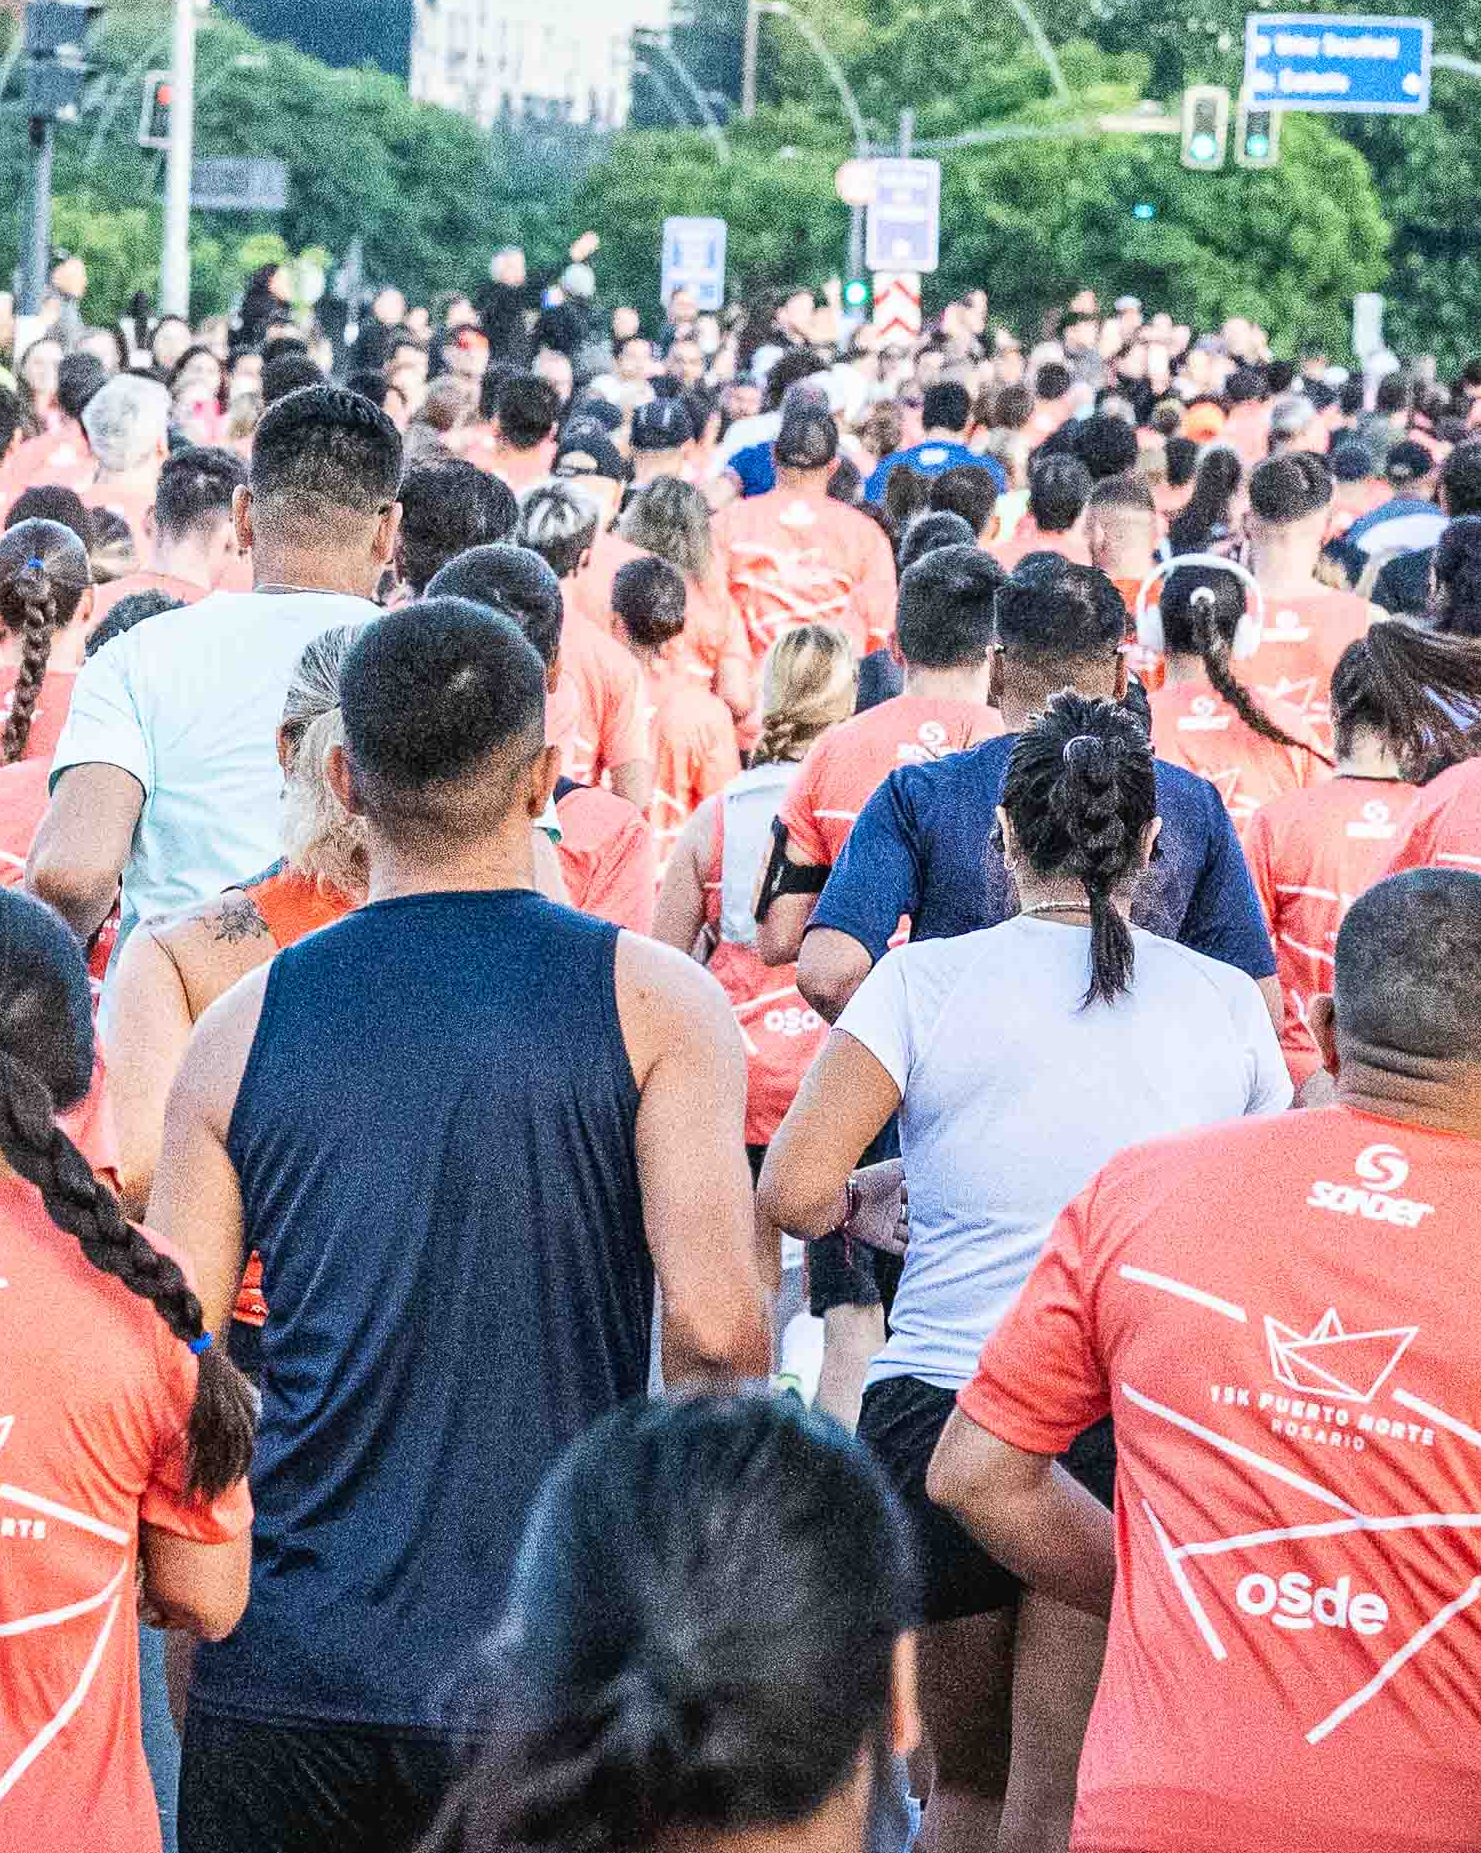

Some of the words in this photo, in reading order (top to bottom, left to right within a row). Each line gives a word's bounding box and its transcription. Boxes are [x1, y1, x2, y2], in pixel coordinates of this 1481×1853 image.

[1258, 1391, 1350, 1427] PUERTO
[1358, 1410, 1436, 1447] NORTE
[1271, 1418, 1365, 1452] ROSARIO
[1235, 1572, 1389, 1637] osde
